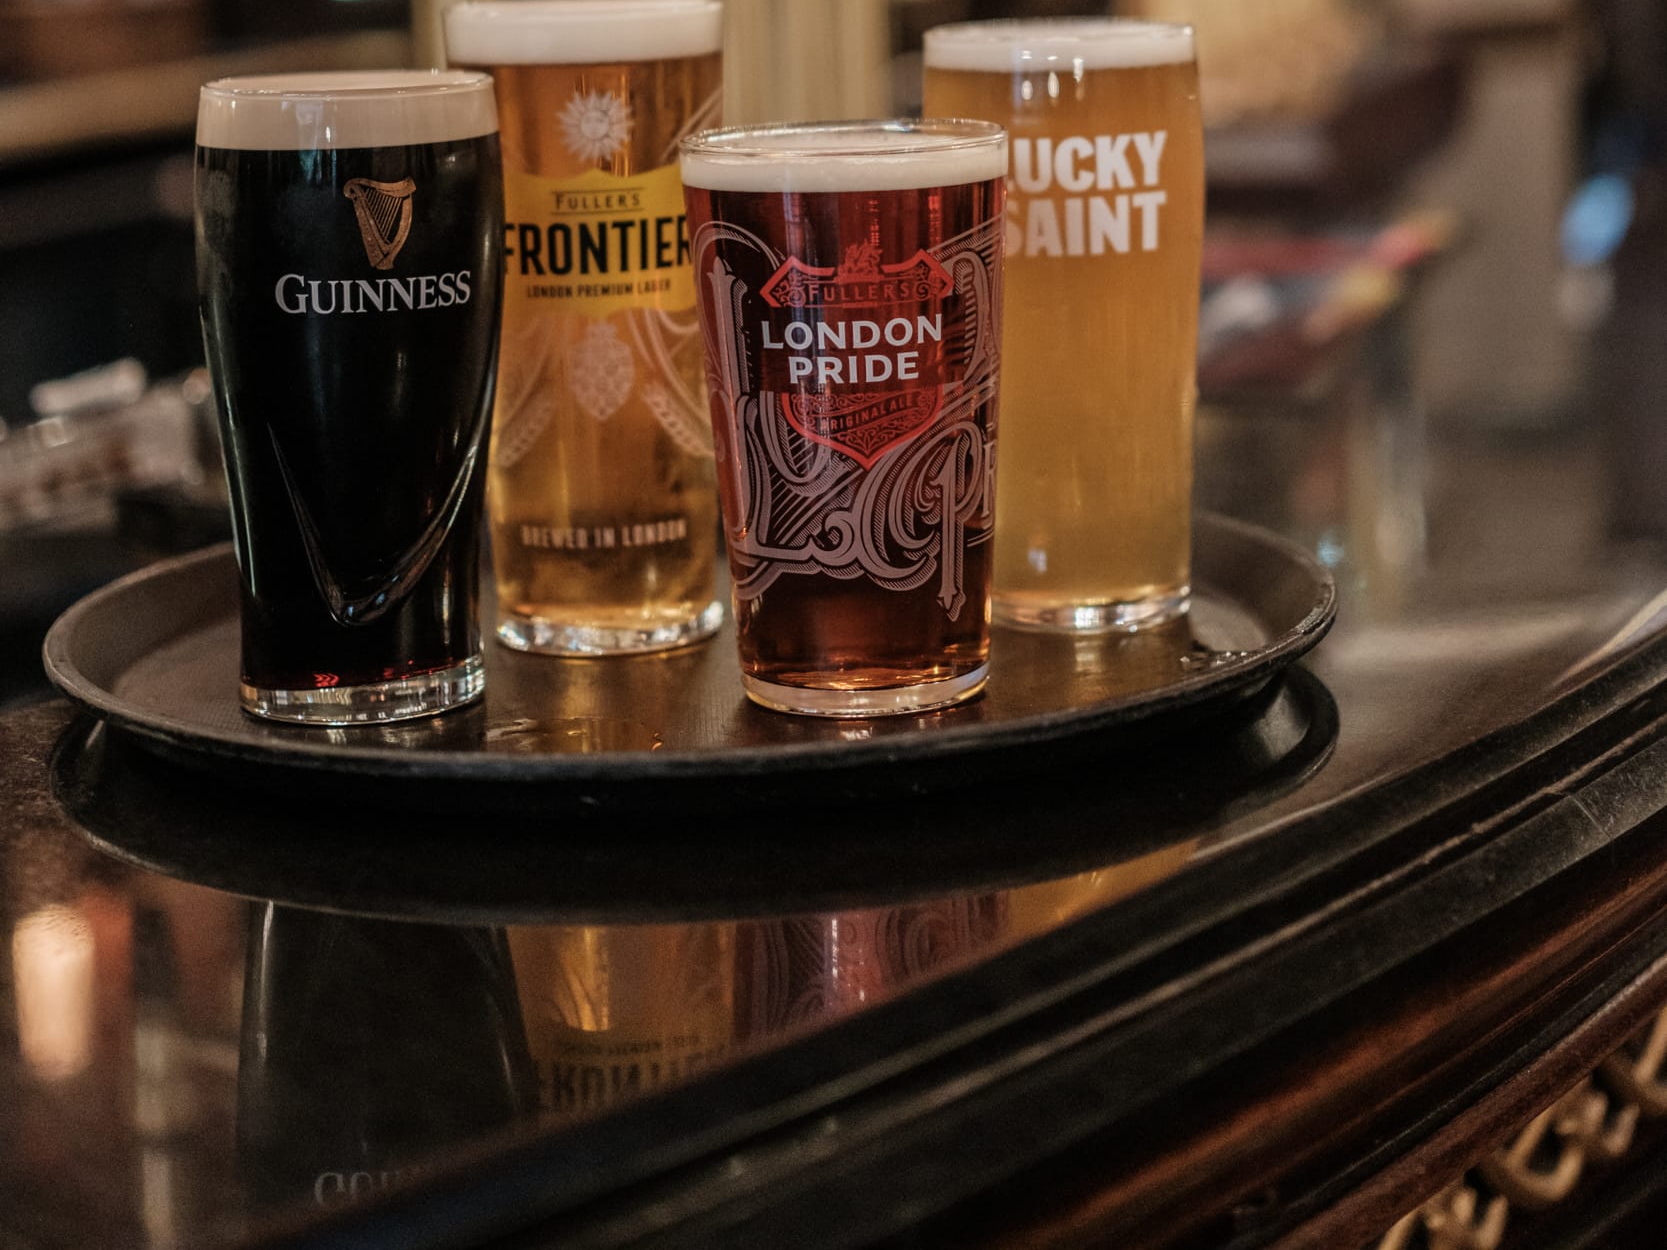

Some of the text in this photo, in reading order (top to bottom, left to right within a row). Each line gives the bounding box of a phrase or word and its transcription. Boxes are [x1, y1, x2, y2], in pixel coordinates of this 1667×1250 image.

[1007, 130, 1167, 193] UCKY
[275, 270, 471, 315] GUINNESS
[761, 313, 942, 350] LONDON
[788, 351, 919, 385] PRIDE
